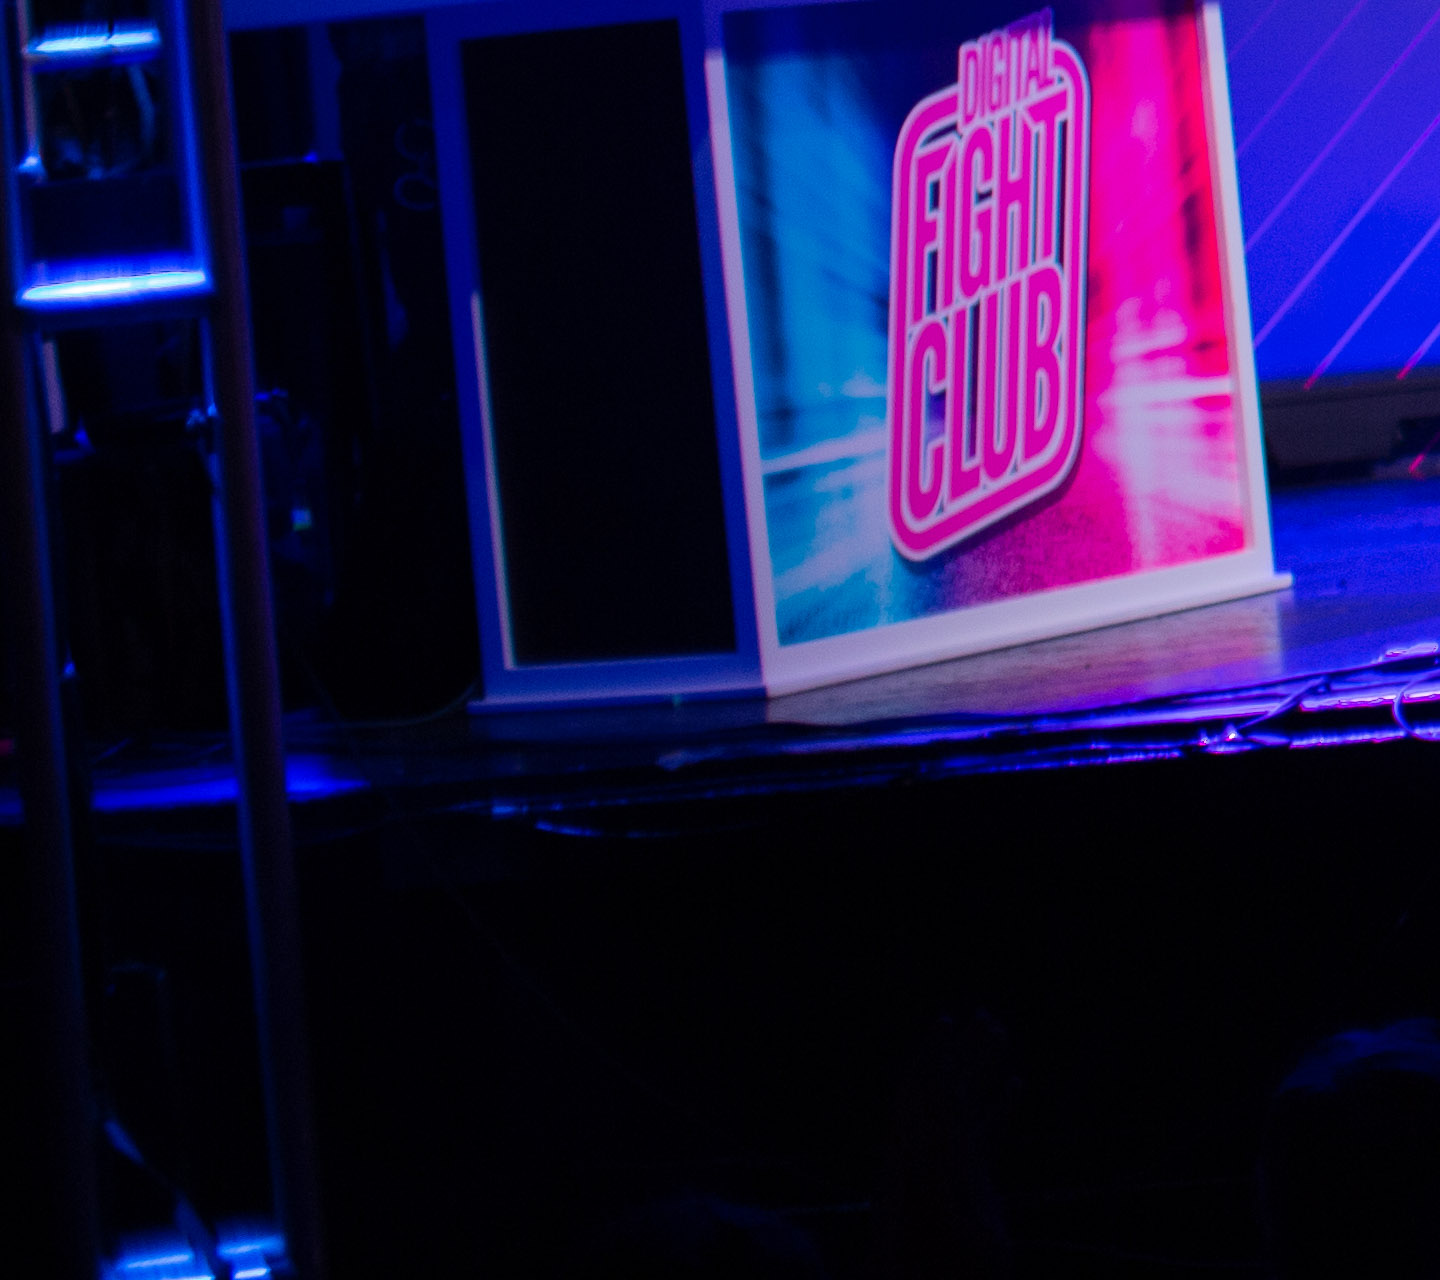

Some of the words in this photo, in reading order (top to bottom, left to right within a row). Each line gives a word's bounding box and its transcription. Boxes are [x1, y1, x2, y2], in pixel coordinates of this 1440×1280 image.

[959, 7, 1055, 130] DIGITAL
[908, 82, 1073, 325] FIGHT
[906, 262, 1067, 525] CLUB
